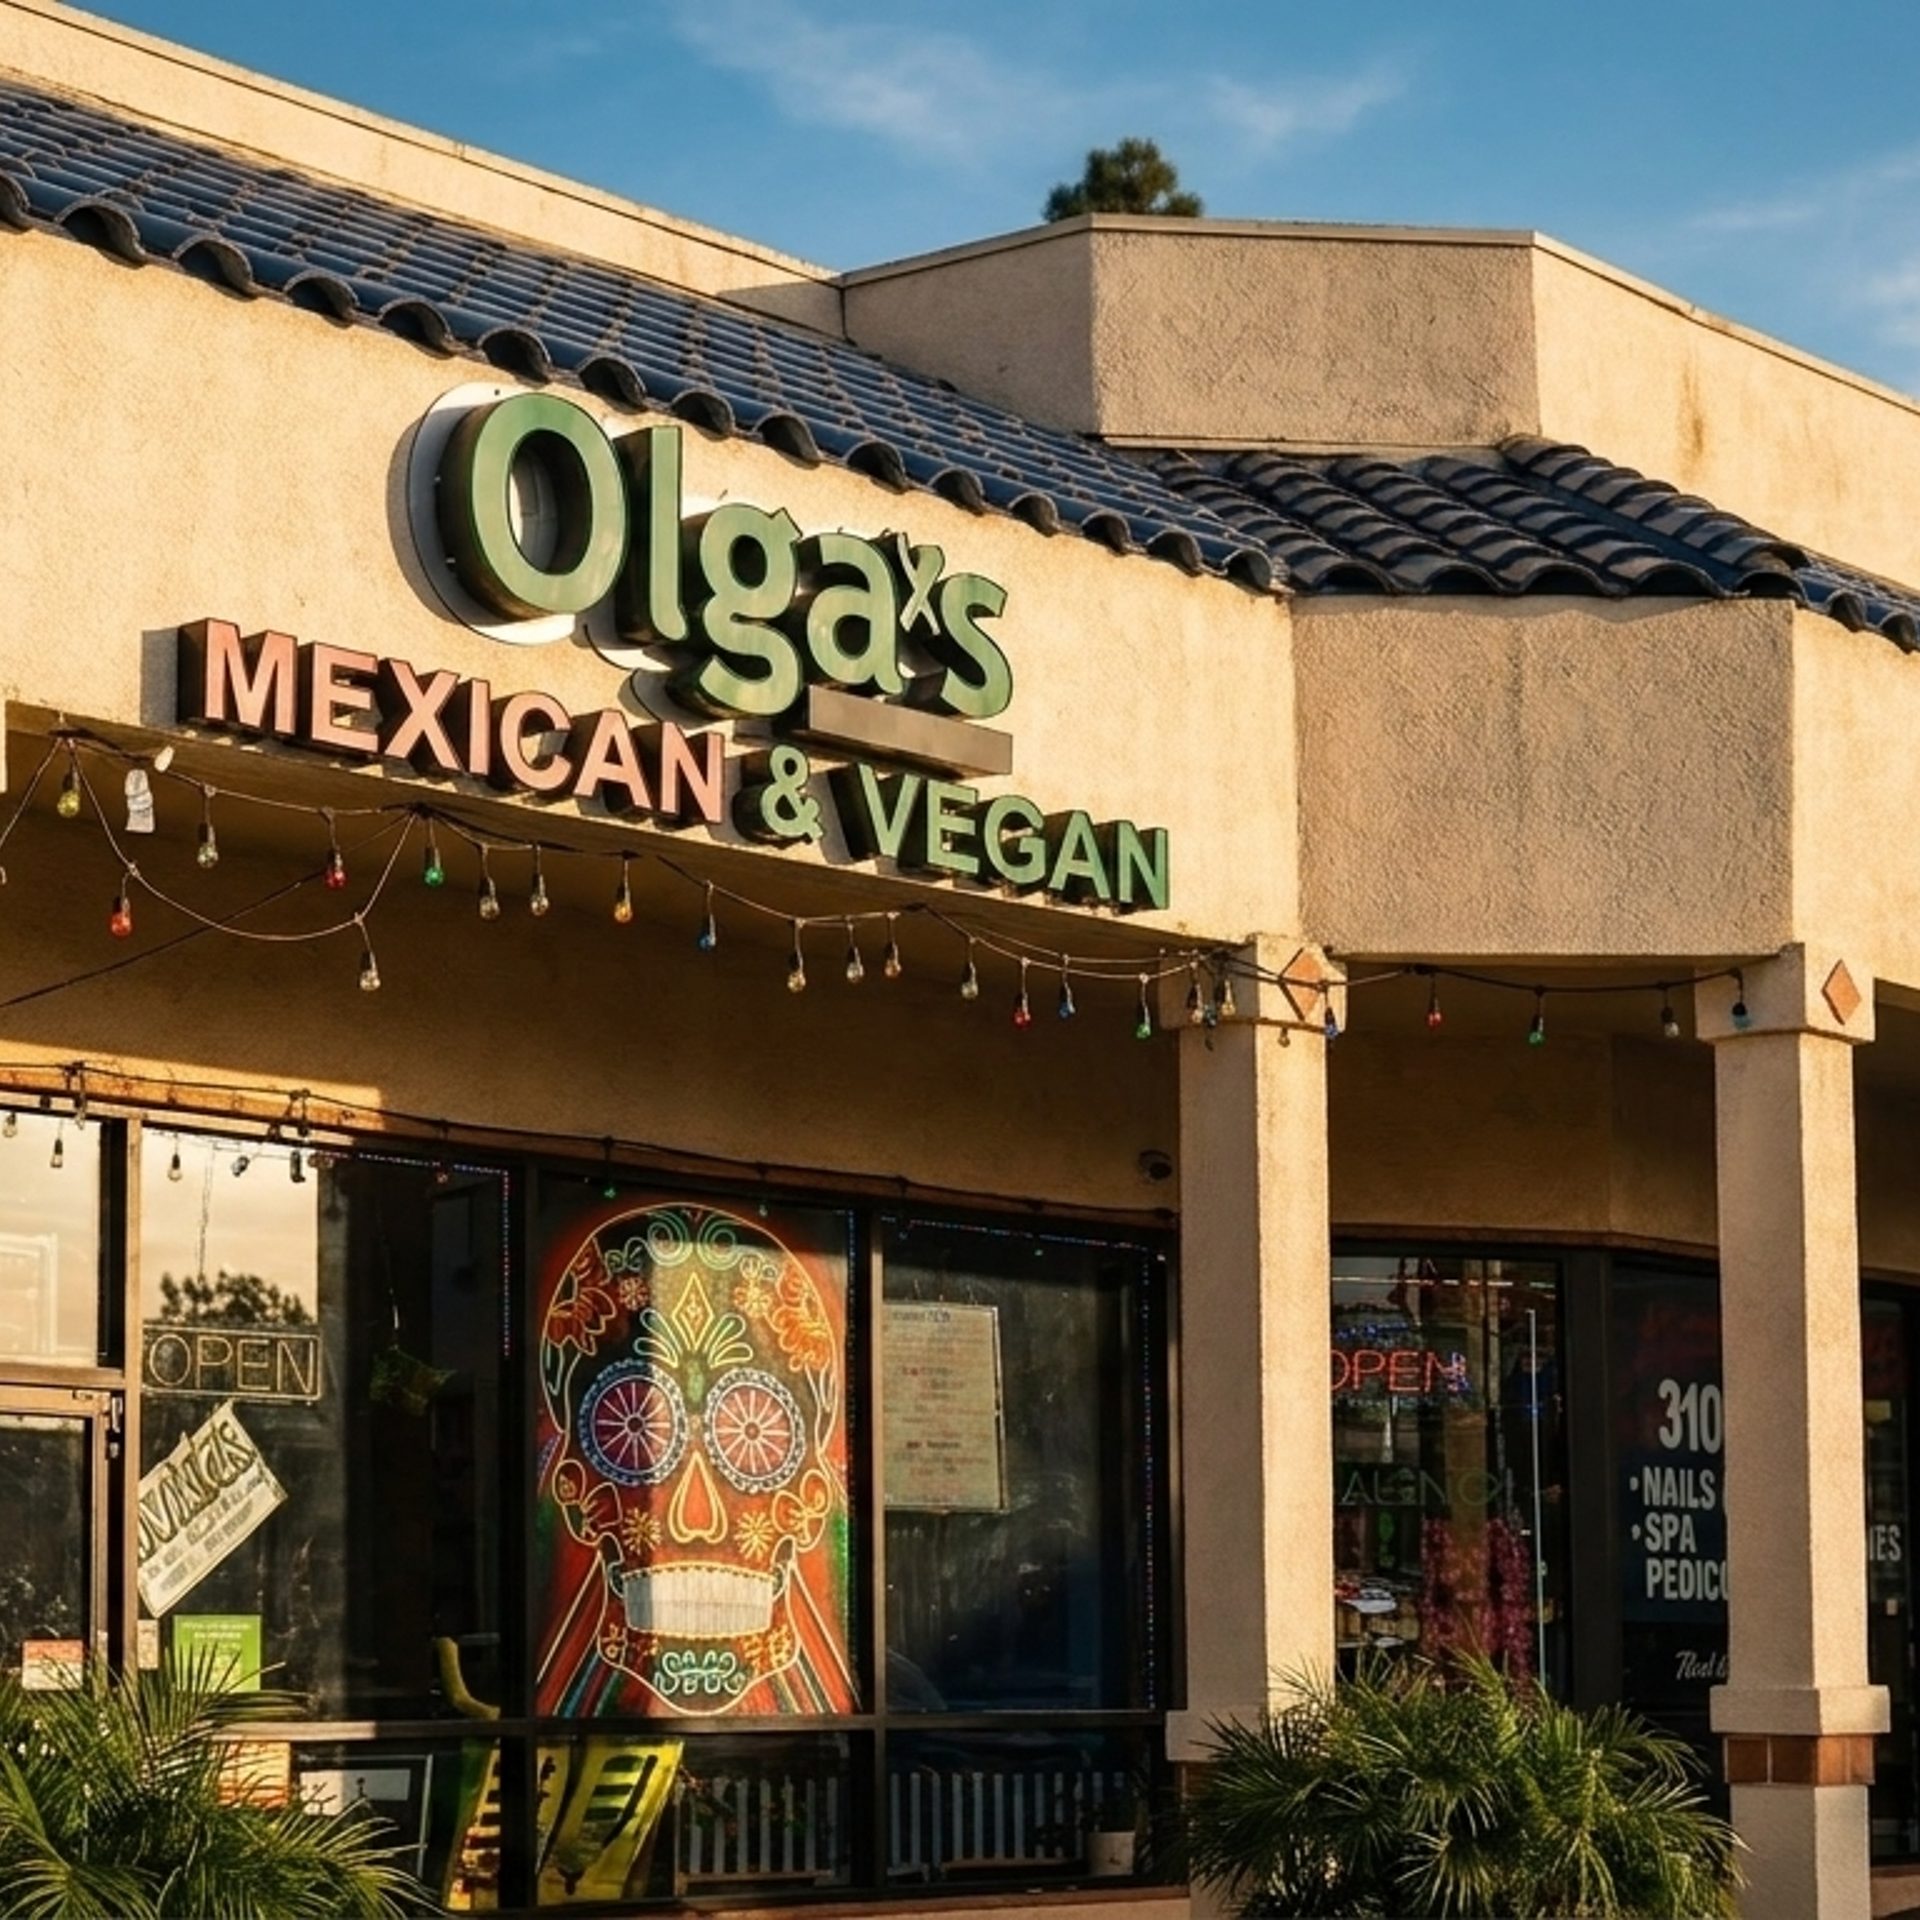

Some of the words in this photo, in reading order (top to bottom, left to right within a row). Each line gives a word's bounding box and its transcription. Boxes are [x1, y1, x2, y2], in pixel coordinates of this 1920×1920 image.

[203, 616, 726, 824] MEXICAN
[760, 744, 824, 844] &
[857, 762, 1170, 910] VEGAN
[149, 1332, 315, 1395] OPEN
[1657, 1378, 1722, 1454] 310
[1642, 1465, 1716, 1511] NAILS
[1644, 1511, 1697, 1553] SPA
